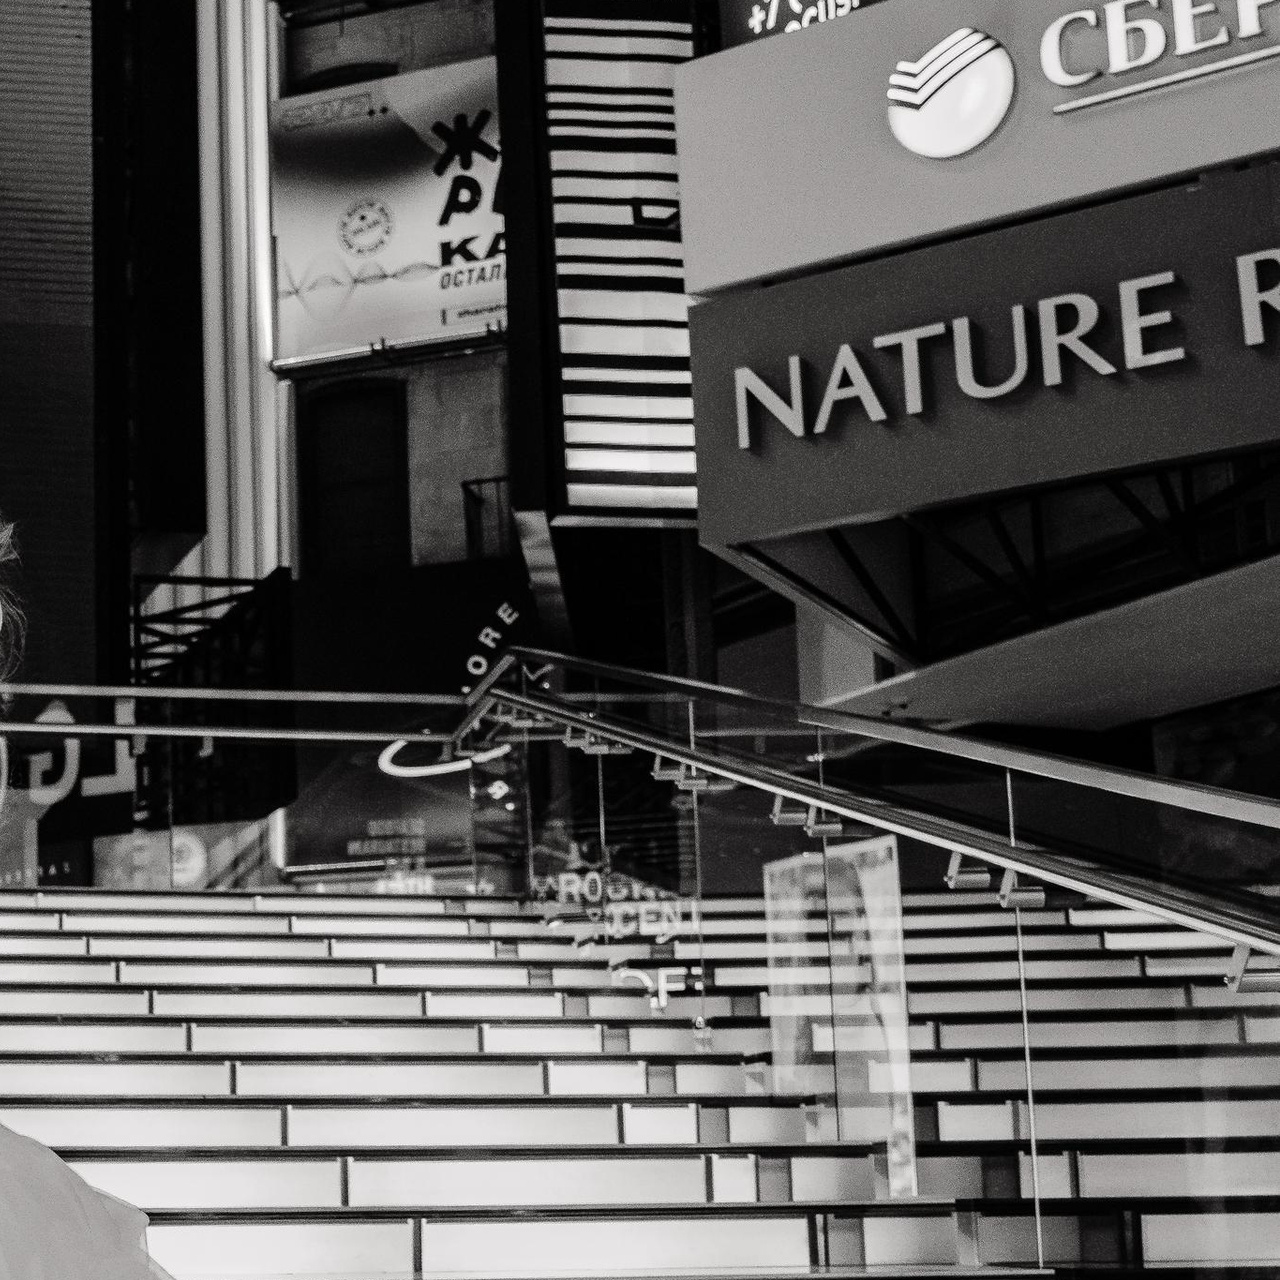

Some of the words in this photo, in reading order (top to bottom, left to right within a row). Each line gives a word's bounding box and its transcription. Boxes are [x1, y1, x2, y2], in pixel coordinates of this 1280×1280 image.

[439, 263, 504, 291] ОСТАЛ
[733, 270, 1187, 450] NATURE
[461, 602, 520, 694] ORE
